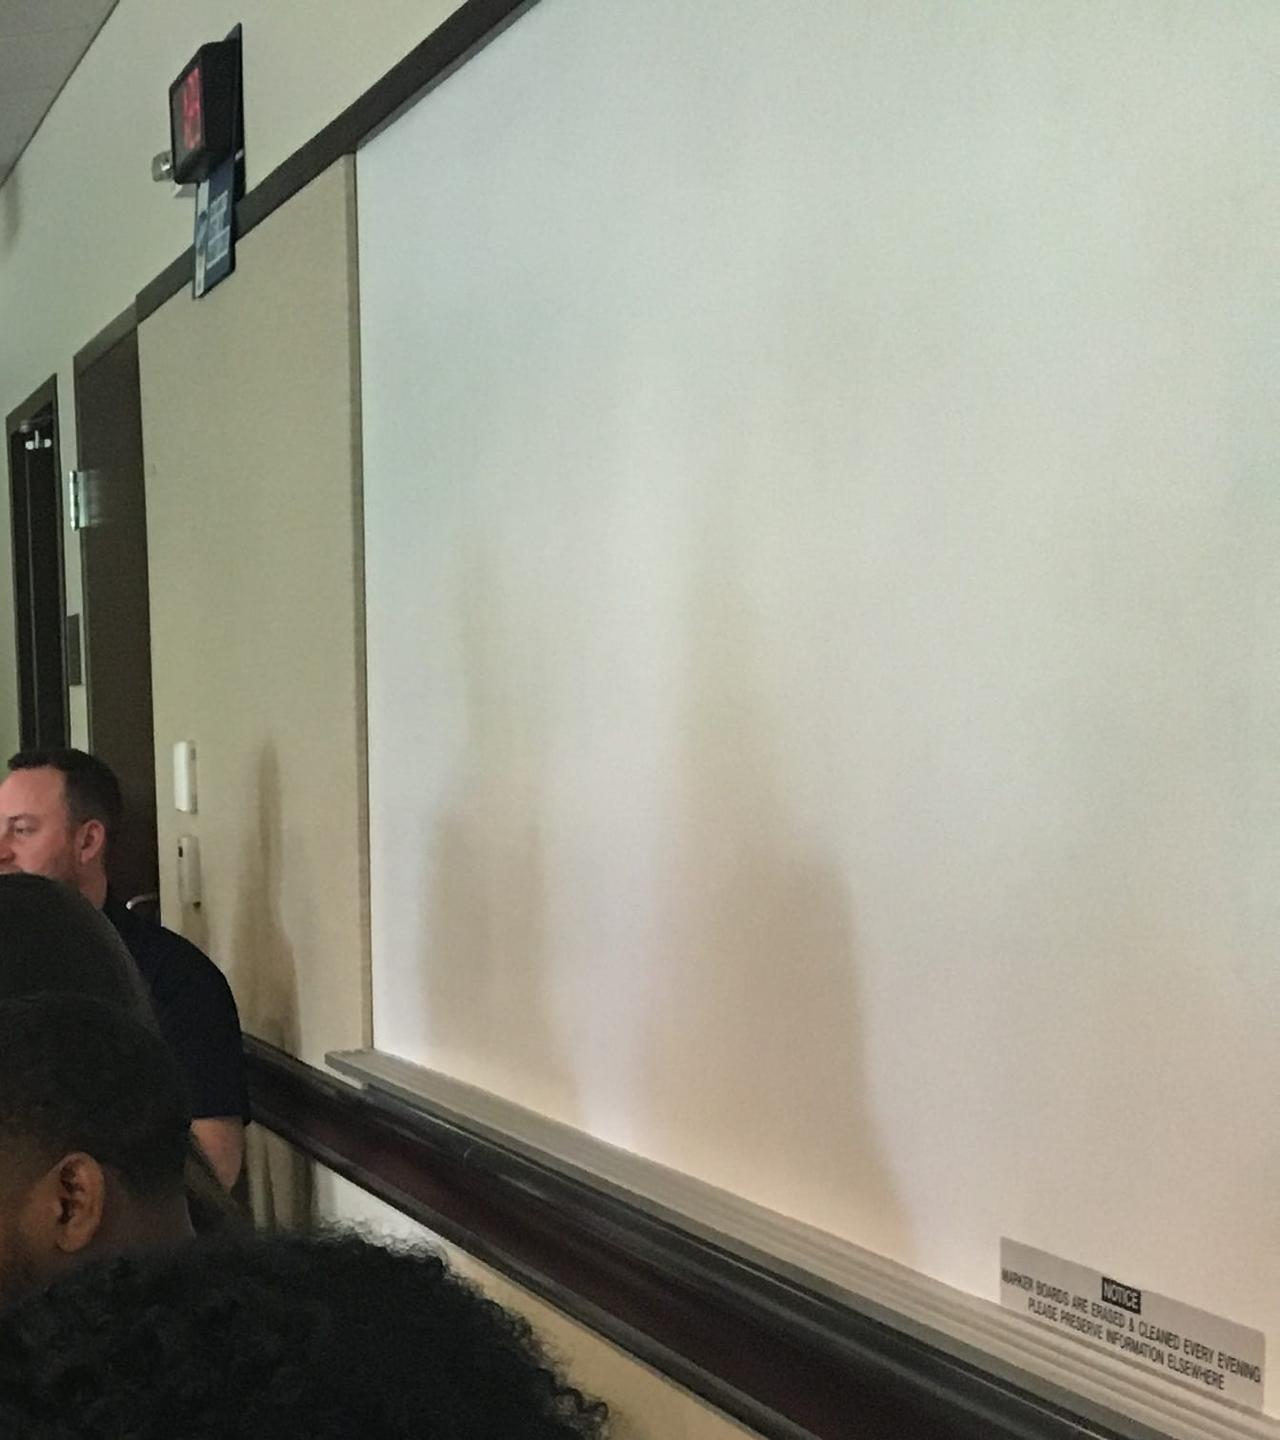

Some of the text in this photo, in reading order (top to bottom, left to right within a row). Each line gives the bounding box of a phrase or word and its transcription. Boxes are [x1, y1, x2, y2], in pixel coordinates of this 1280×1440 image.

[1001, 1268, 1261, 1384] MARKER BOARDS ARE ERASED & CLEANED EVERY EVENING
[1103, 1279, 1139, 1311] NOTICE
[1028, 1297, 1225, 1391] PLEASE PRESERVE INFORMATION ELSEWHERE
